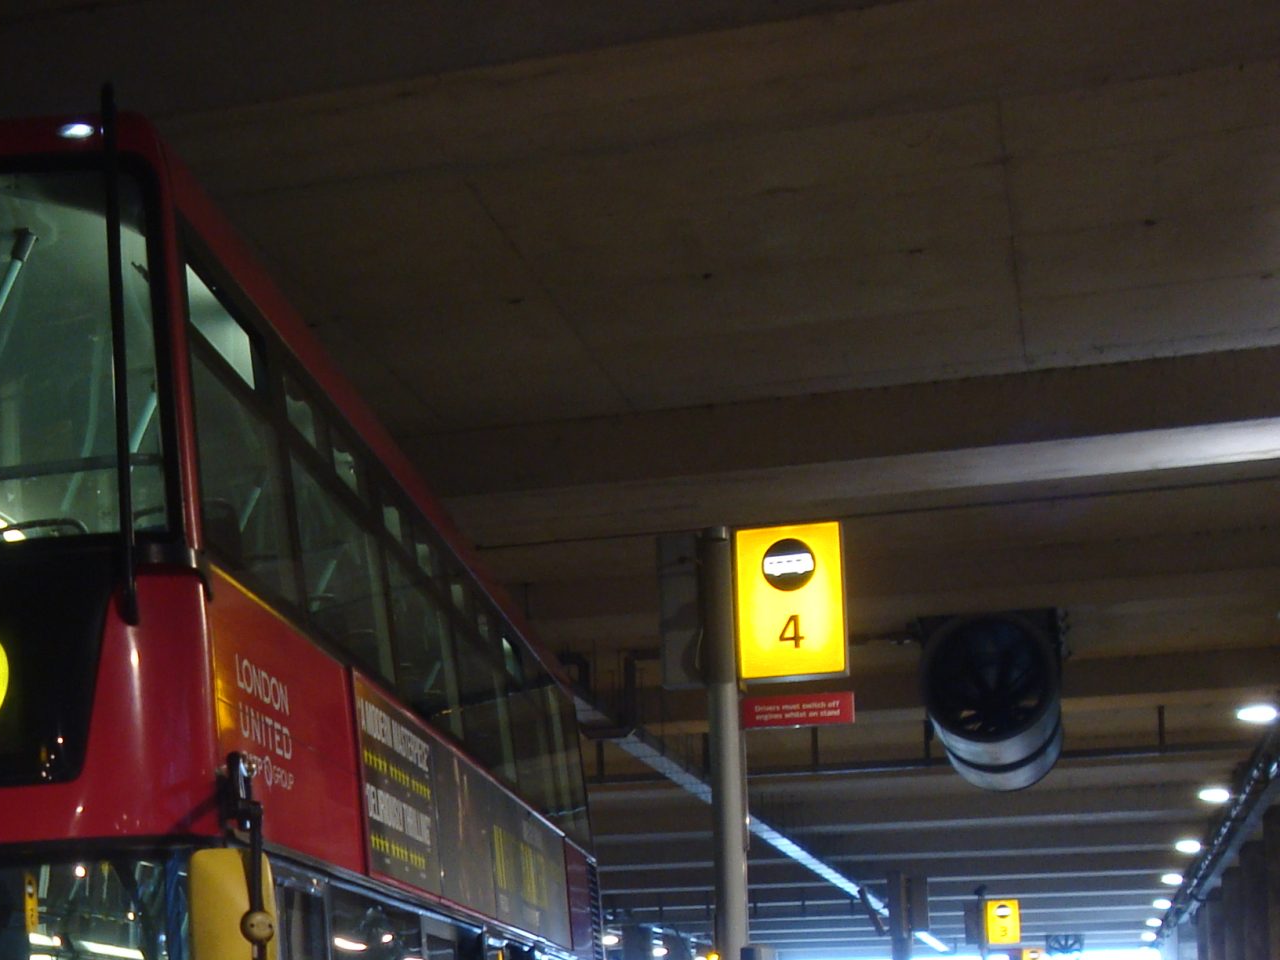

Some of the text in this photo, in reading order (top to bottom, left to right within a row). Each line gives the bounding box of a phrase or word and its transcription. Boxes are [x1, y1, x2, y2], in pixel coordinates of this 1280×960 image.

[778, 614, 805, 649] 4
[234, 652, 290, 717] LONDON
[238, 701, 293, 760] UNITED
